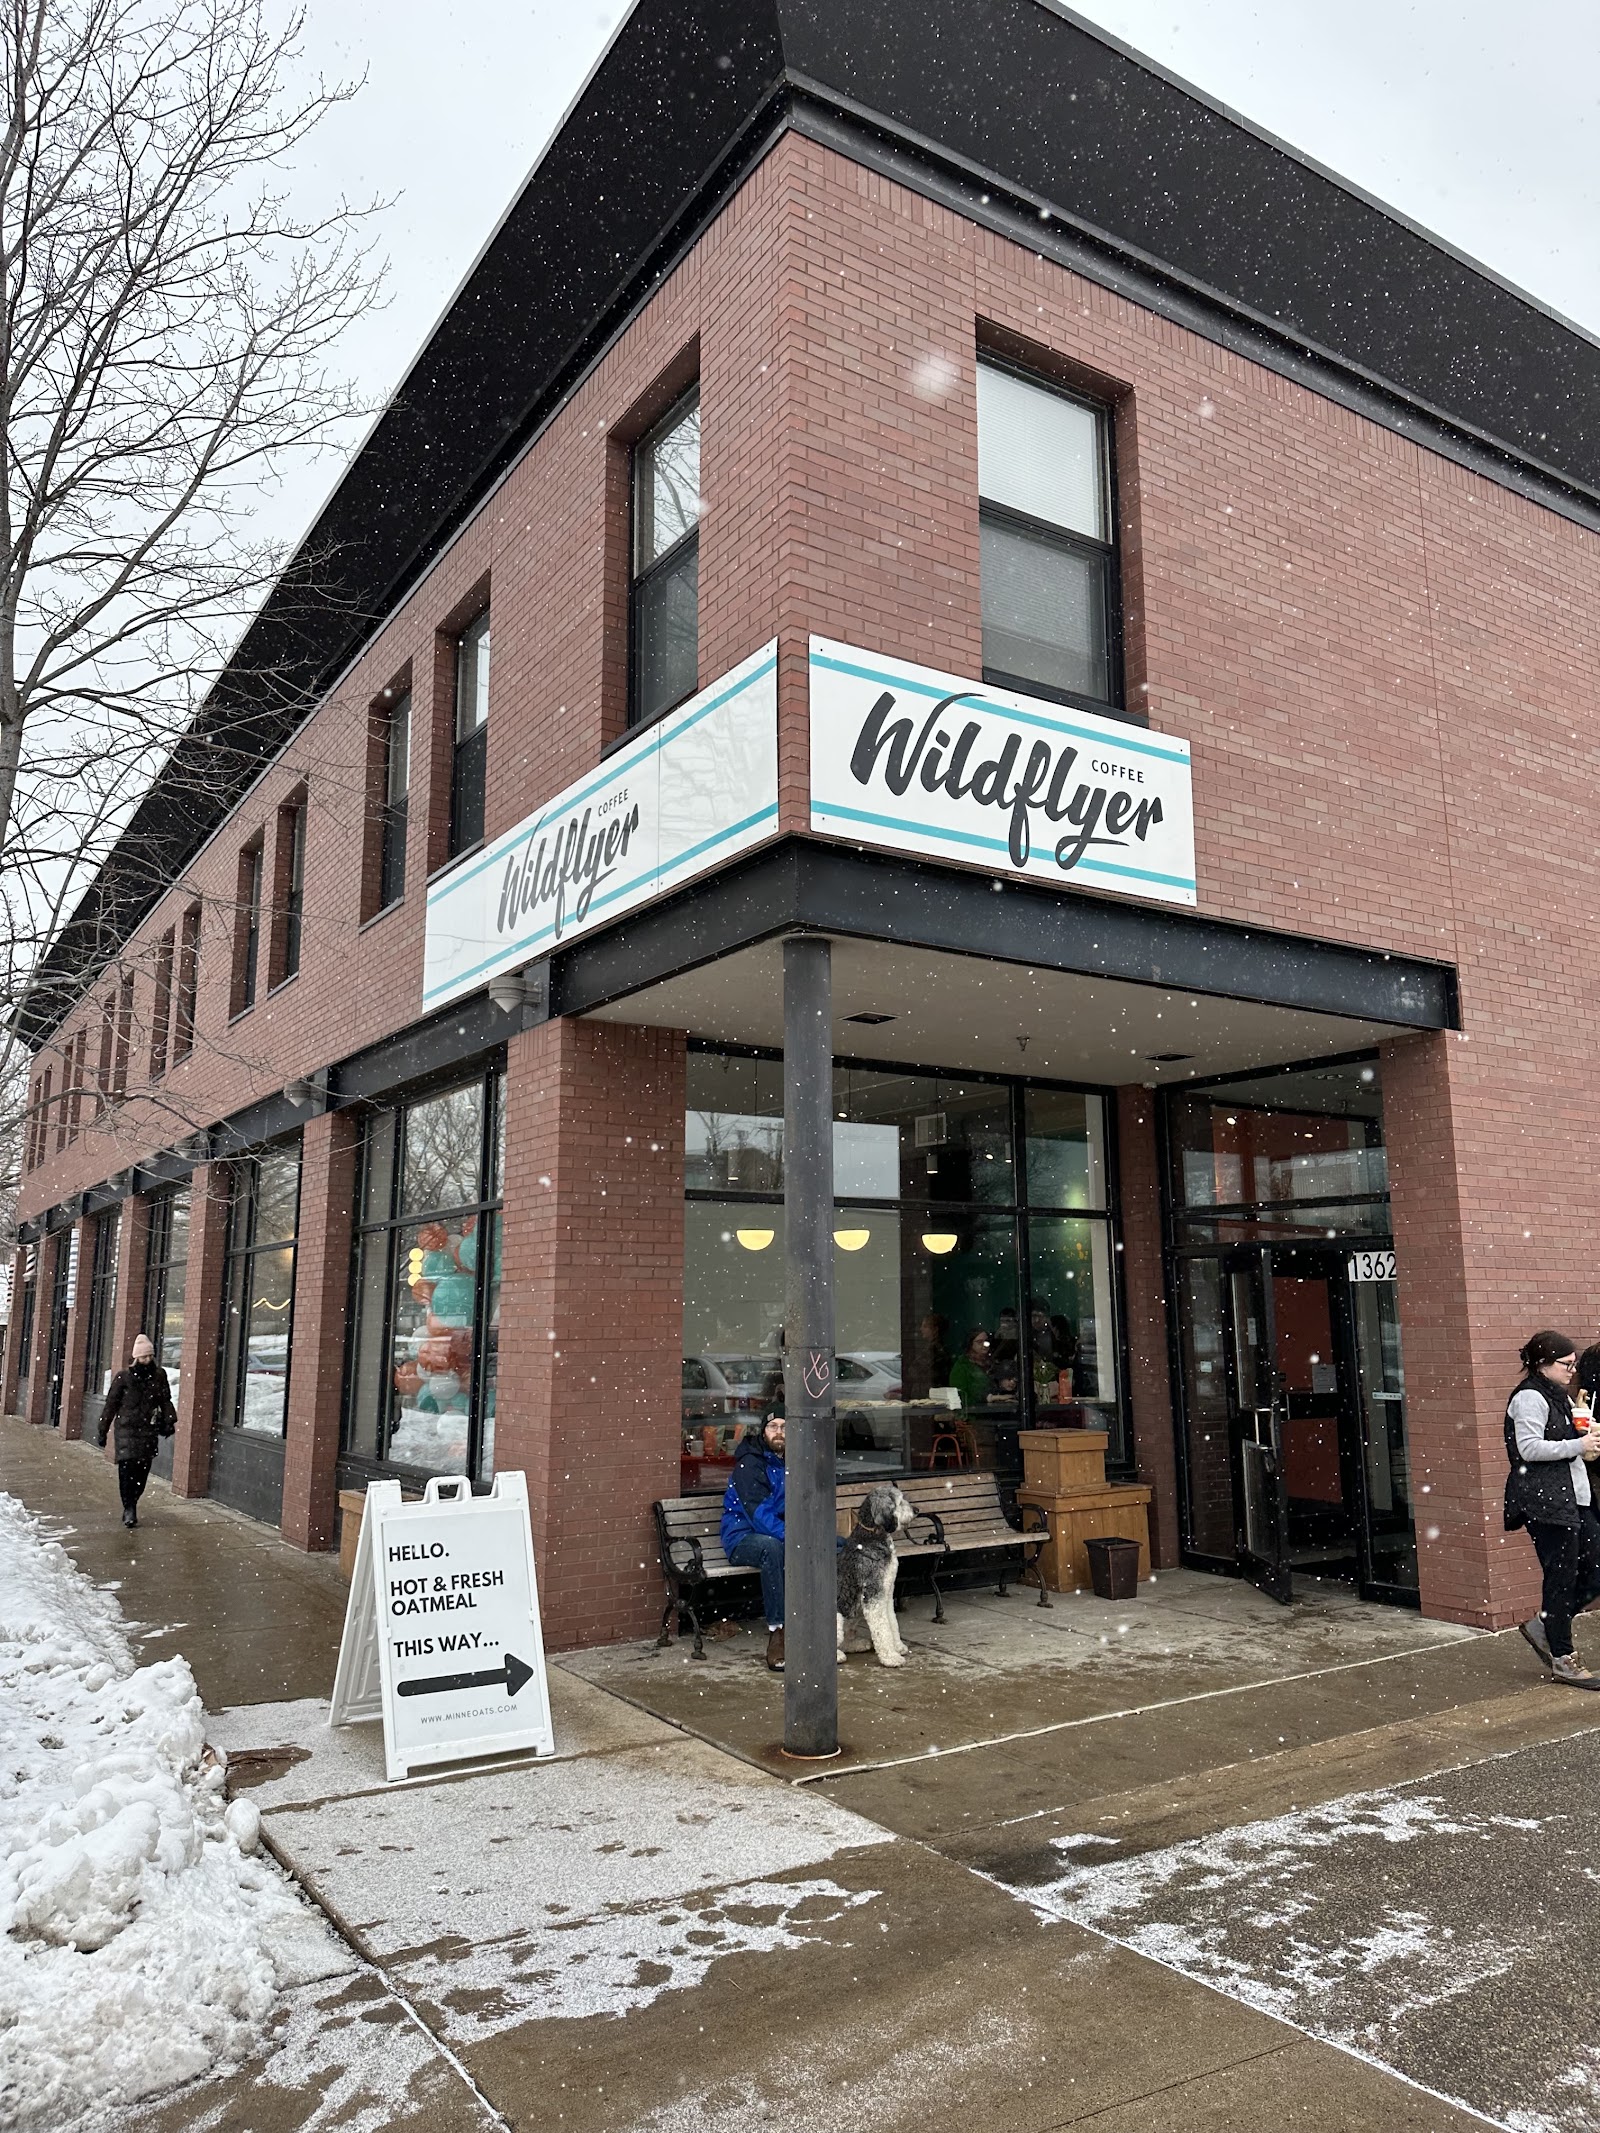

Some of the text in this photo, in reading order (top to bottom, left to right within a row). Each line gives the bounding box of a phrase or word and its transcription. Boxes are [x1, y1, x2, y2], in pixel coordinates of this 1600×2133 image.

[849, 691, 1164, 870] Wildflyer
[1091, 759, 1145, 784] COFFEE
[597, 788, 629, 817] COFFEE
[496, 803, 640, 940] Wildflyer
[1351, 1252, 1397, 1280] 1362
[389, 1542, 450, 1562] HELLO.
[390, 1570, 504, 1597] HOT & FRESH
[391, 1592, 478, 1616] OATMEAL
[393, 1632, 499, 1658] THIS WAY...
[420, 1704, 518, 1724] WWW.MINNEOATS.COM
